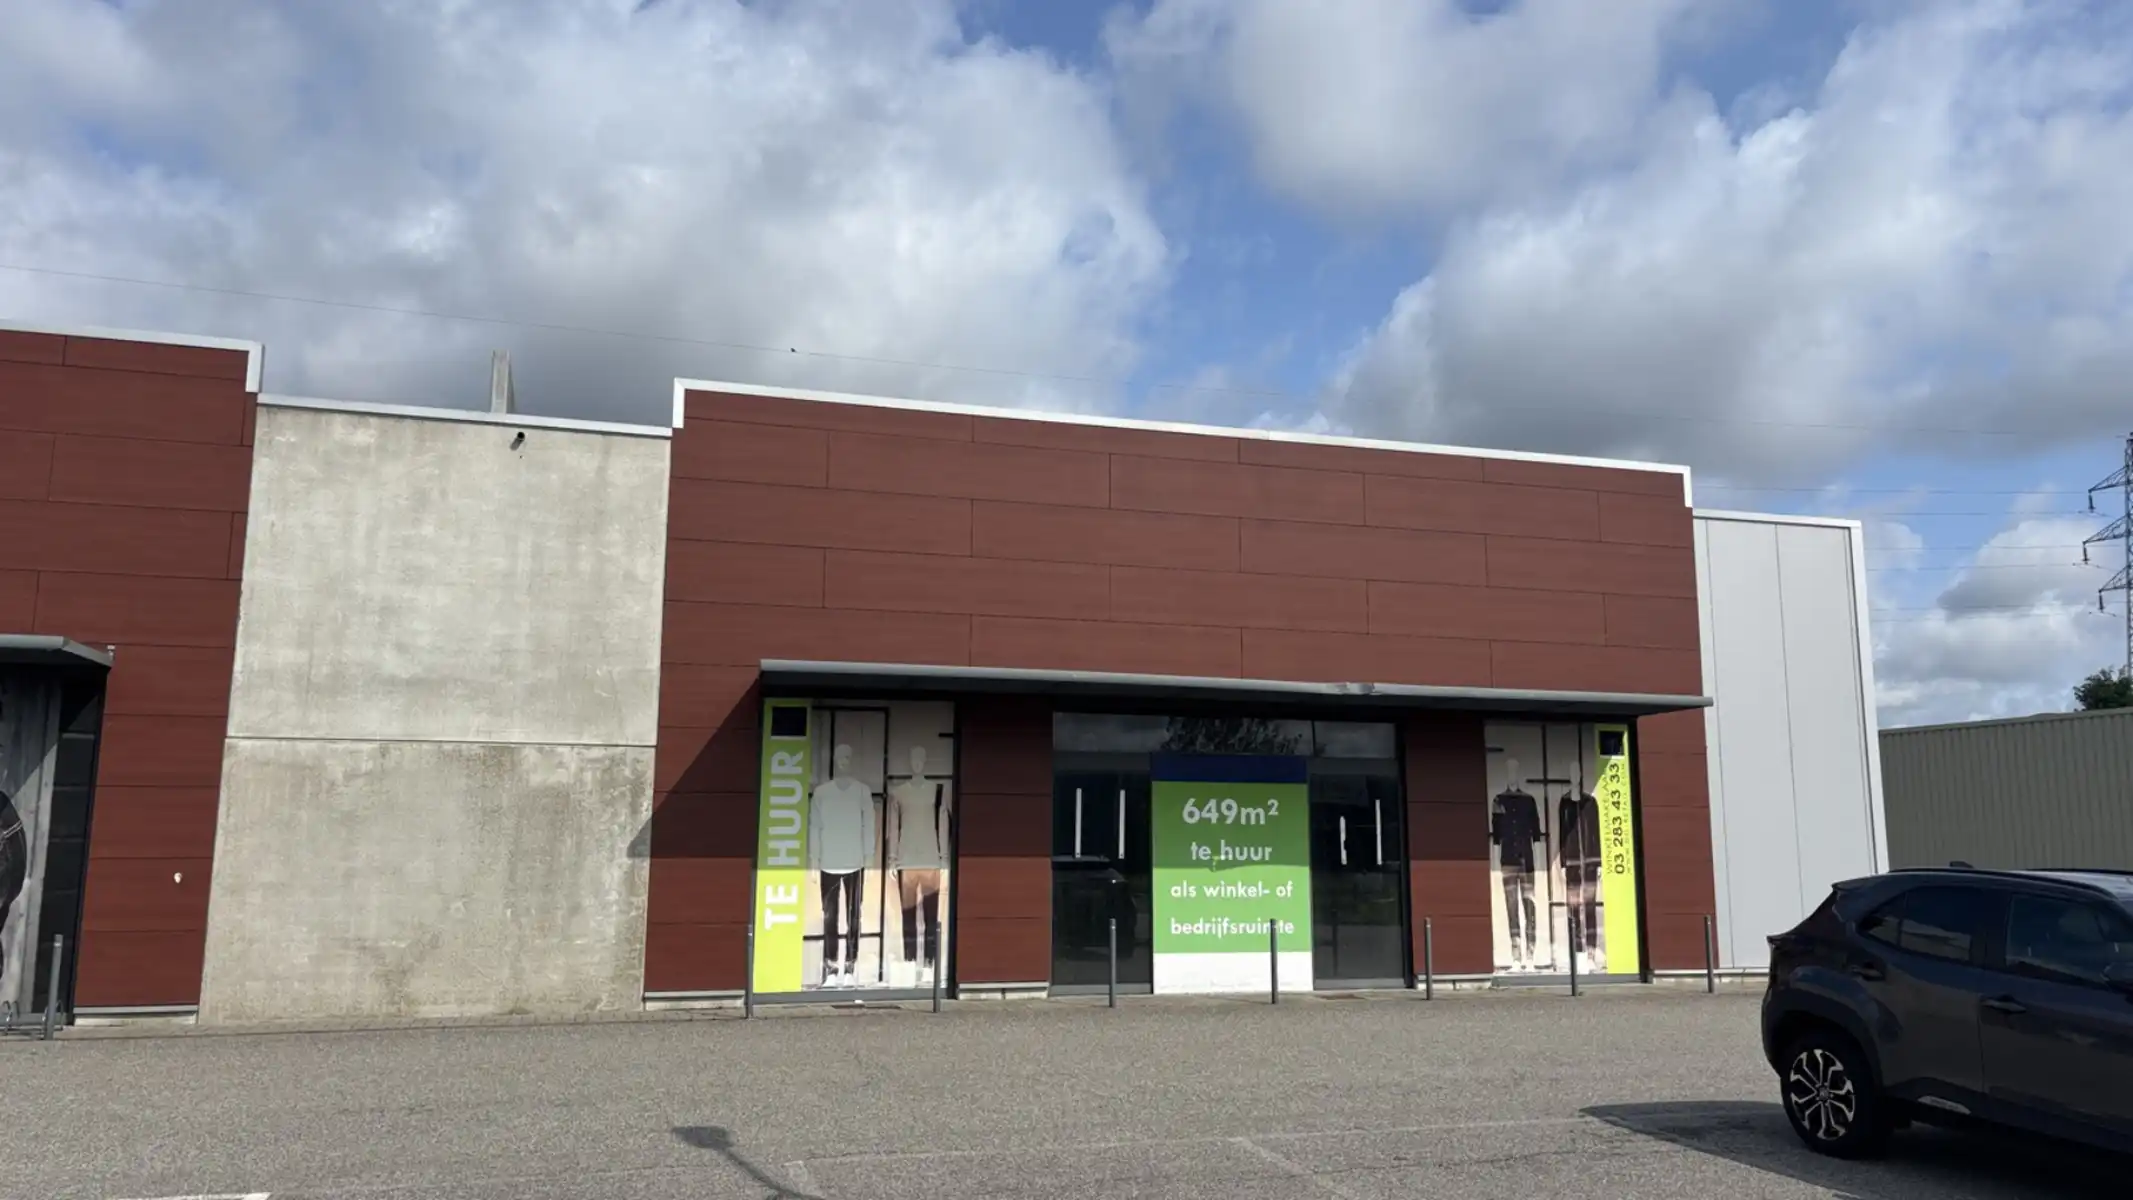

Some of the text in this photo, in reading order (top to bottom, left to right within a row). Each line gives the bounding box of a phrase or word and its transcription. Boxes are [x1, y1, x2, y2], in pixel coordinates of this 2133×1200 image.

[765, 751, 803, 930] TE HUUR
[1191, 840, 1272, 861] te huur
[1609, 762, 1625, 874] 03 283 43 33
[1171, 881, 1293, 898] als winkel- of
